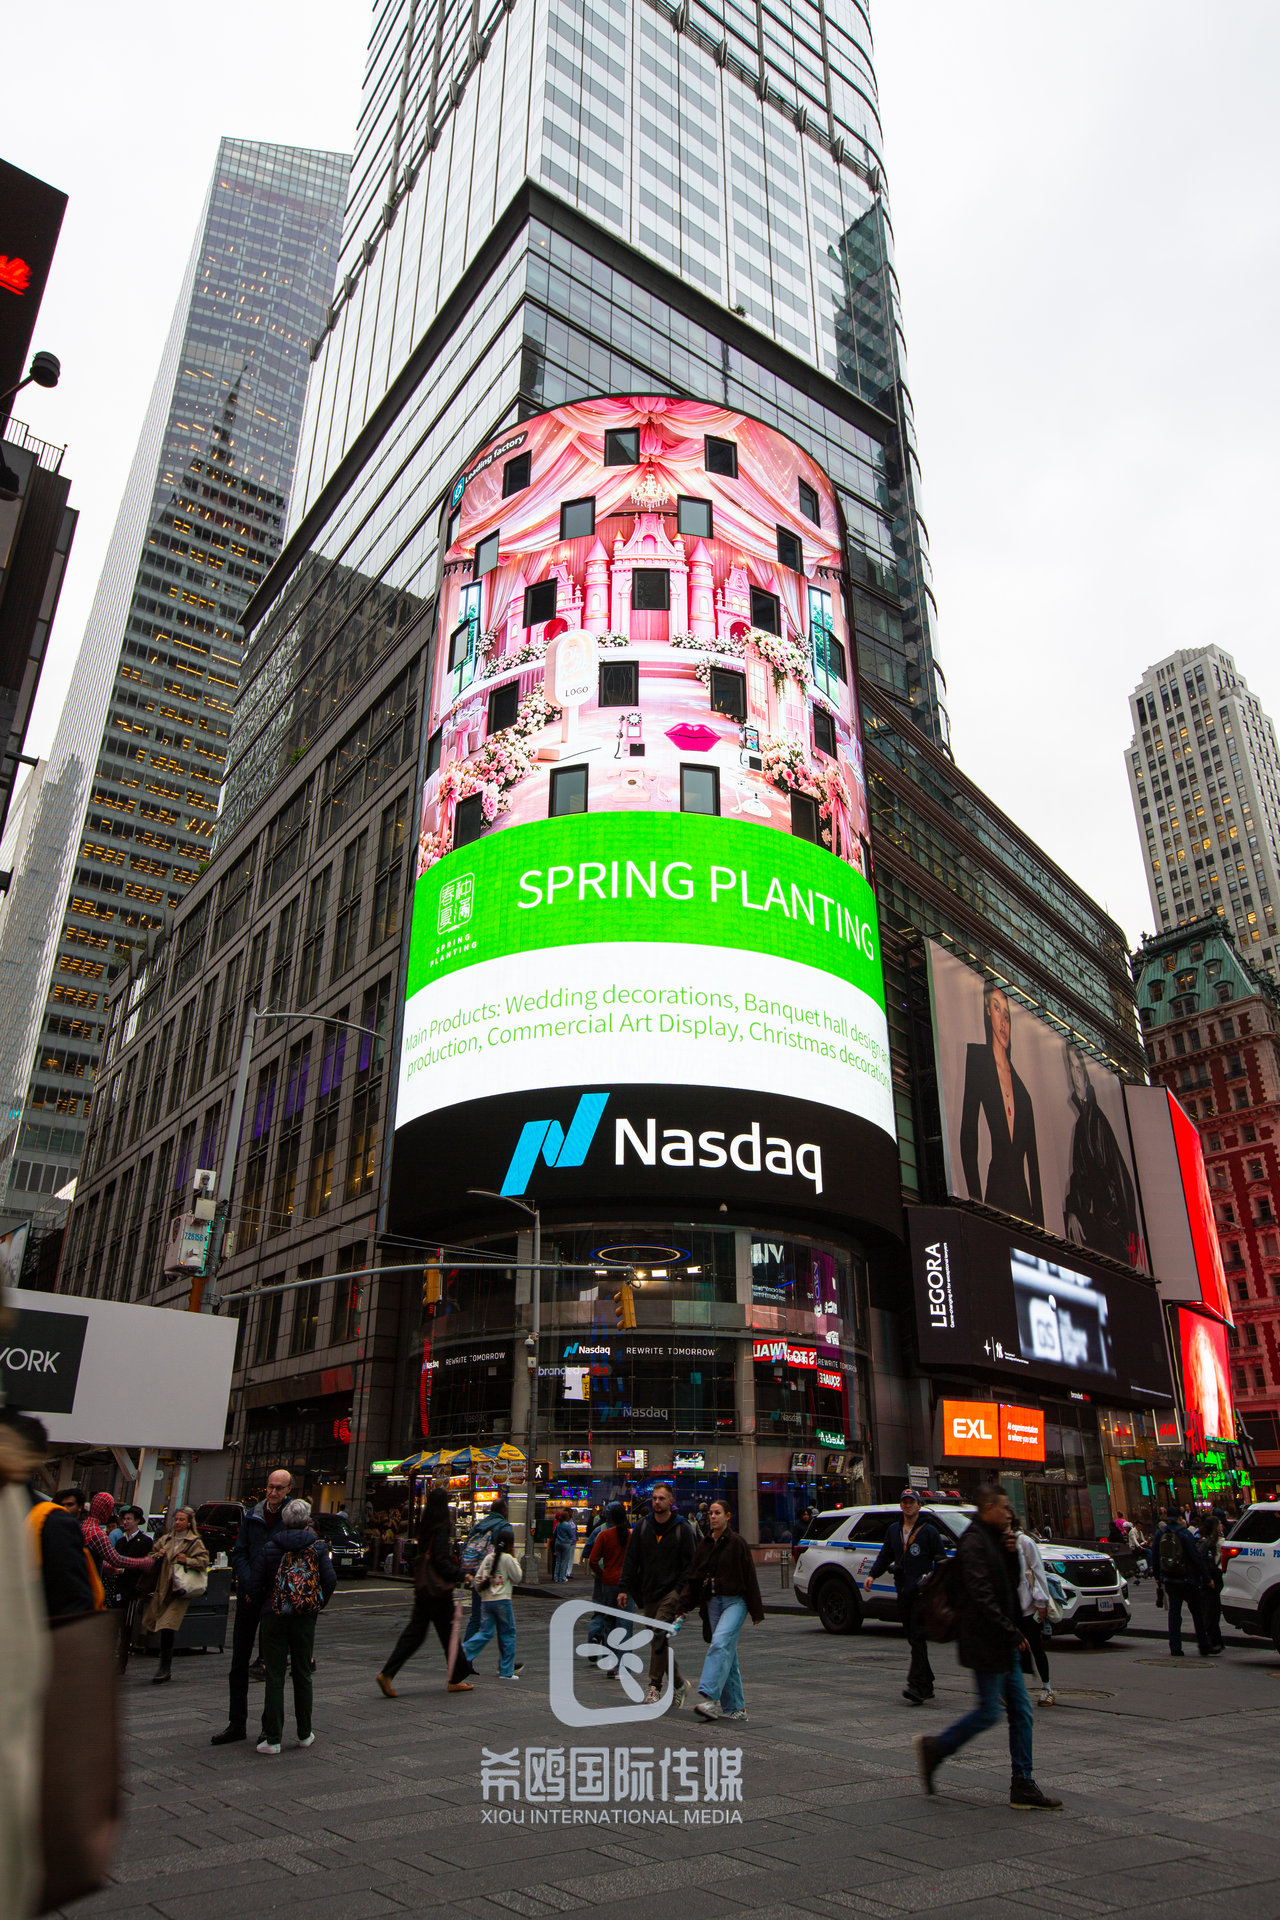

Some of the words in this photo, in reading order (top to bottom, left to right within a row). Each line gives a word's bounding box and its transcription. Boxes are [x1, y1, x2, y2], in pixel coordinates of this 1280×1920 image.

[465, 455, 492, 484] Leading
[493, 434, 525, 458] factory
[565, 686, 589, 697] LOGO
[517, 860, 694, 909] SPRING
[710, 865, 874, 961] PLANTING
[429, 942, 478, 968] PLANTING
[435, 934, 471, 954] SPRING
[405, 1028, 427, 1052] Main
[430, 1003, 501, 1039] Products:
[505, 988, 598, 1015] Wedding
[603, 984, 739, 1013] decorations,
[744, 993, 821, 1027] Banquet
[823, 1010, 848, 1039] hall
[850, 1024, 880, 1059] design
[406, 1036, 483, 1082] production,
[487, 1012, 613, 1046] Commercial
[619, 1013, 653, 1033] Art
[659, 1013, 744, 1042] Display,
[749, 1022, 836, 1060] Christmas
[615, 1118, 823, 1195] Nasdaq
[924, 1242, 948, 1328] LEGORA
[445, 1356, 467, 1366] REWRITE
[470, 1352, 506, 1362] TOMORROW
[578, 1345, 611, 1356] Nasdaq
[626, 1347, 664, 1355] REWRITE
[668, 1347, 716, 1356] TOMORROW
[623, 1406, 669, 1421] Nasdaq
[953, 1418, 992, 1439] EXL
